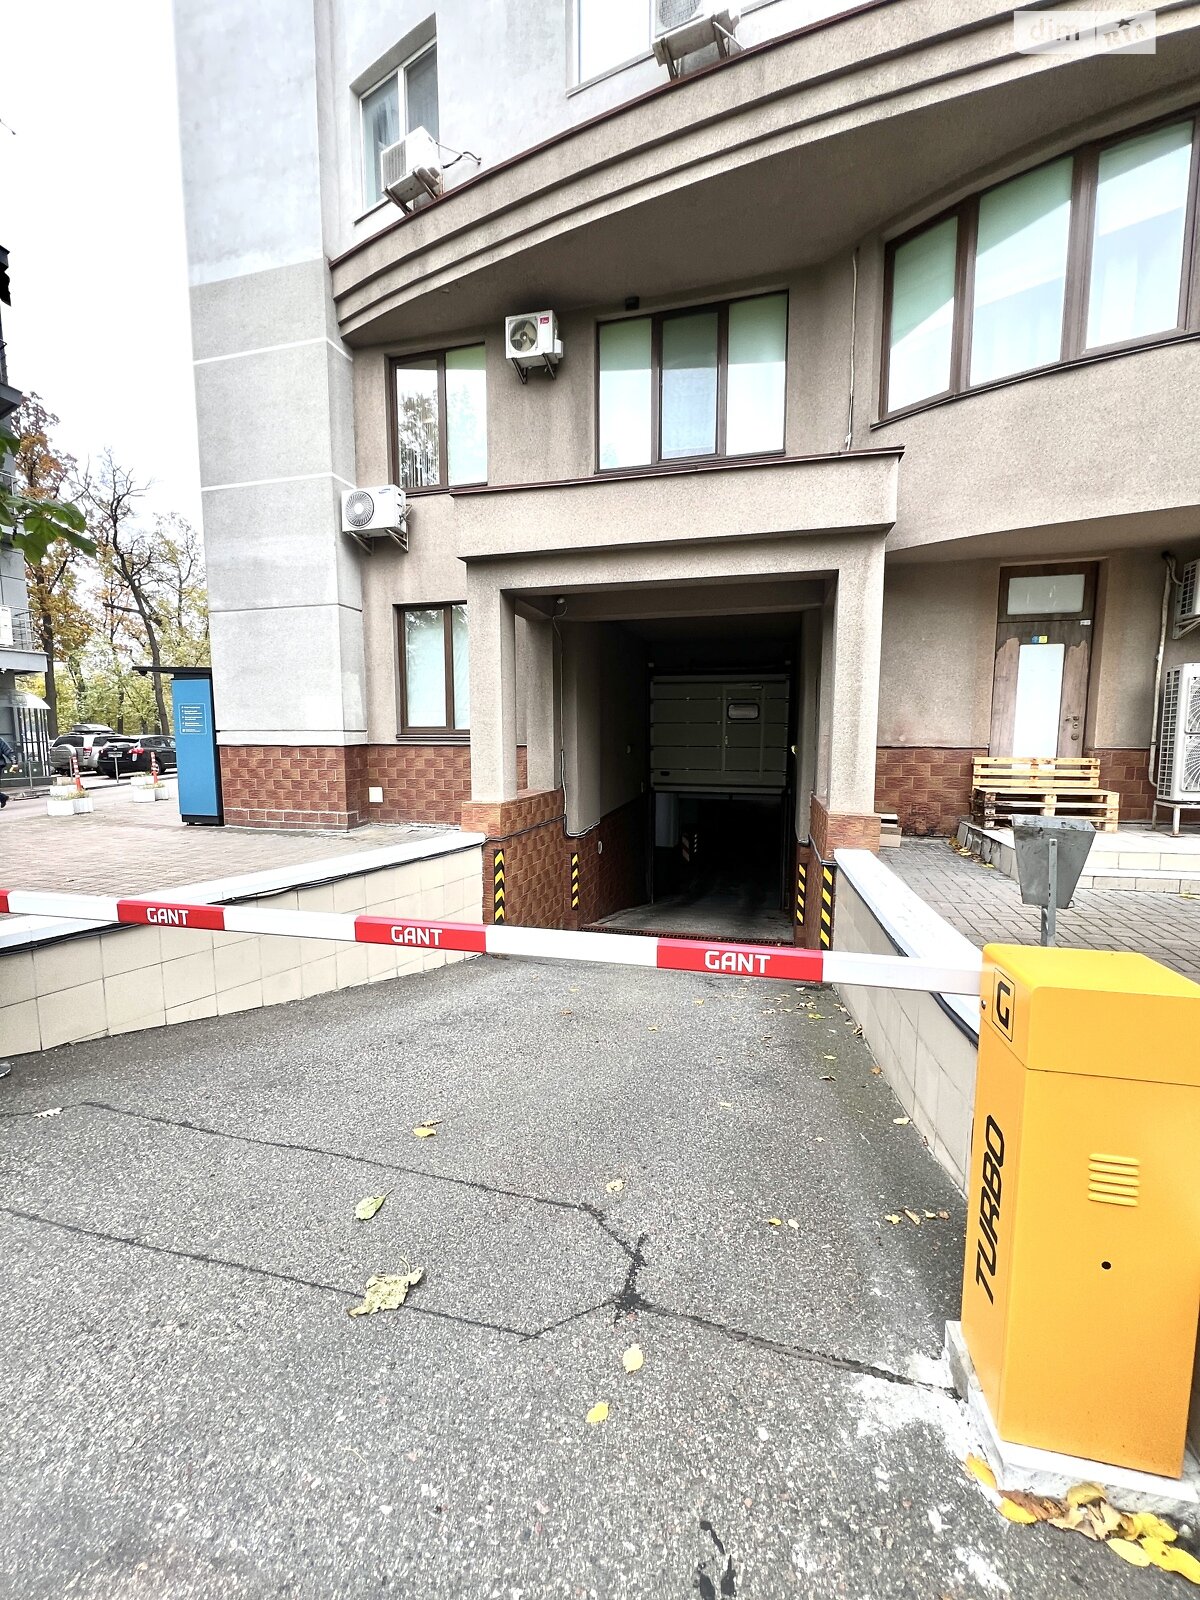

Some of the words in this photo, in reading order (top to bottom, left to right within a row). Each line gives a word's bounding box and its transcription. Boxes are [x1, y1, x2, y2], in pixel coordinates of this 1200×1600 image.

[146, 907, 189, 926] GANT
[390, 925, 443, 946] GANT
[704, 950, 771, 974] GANT
[996, 980, 1011, 1030] G
[975, 1114, 1006, 1305] TURBO
